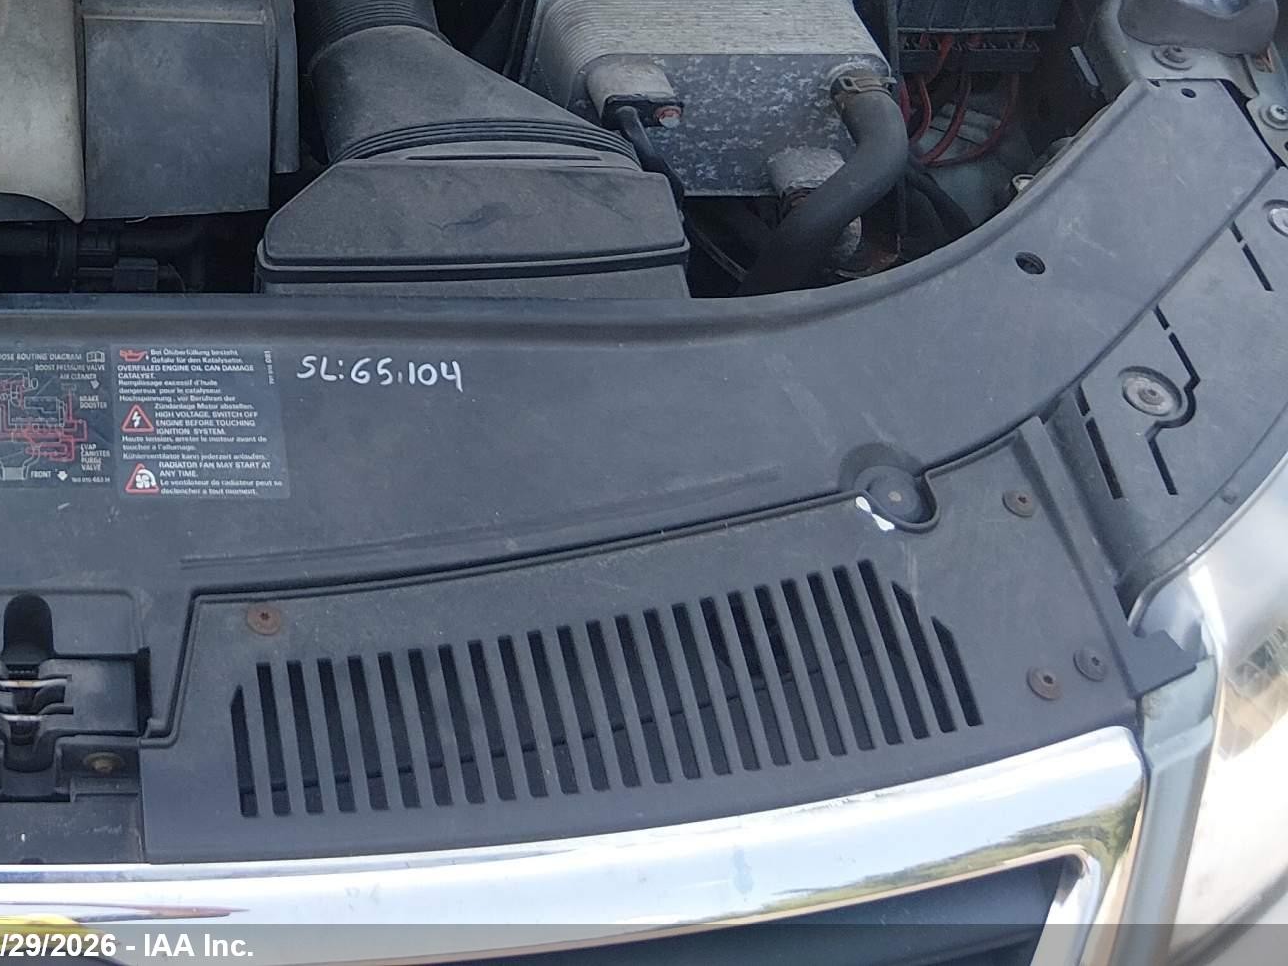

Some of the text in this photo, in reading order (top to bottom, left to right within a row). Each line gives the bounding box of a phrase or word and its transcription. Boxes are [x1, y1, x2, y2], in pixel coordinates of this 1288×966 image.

[16, 353, 47, 361] ROUTING
[49, 353, 82, 361] DIAGRAM
[117, 364, 254, 372] OVERFILLED ENGINE OIL CAN DAMAGE
[155, 419, 256, 427] ENGINE BEFORE TOUCHING
[80, 456, 102, 464] PURGE
[159, 461, 271, 469] RADIATOR FAN MAY START AT
[30, 470, 52, 478] FRONT
